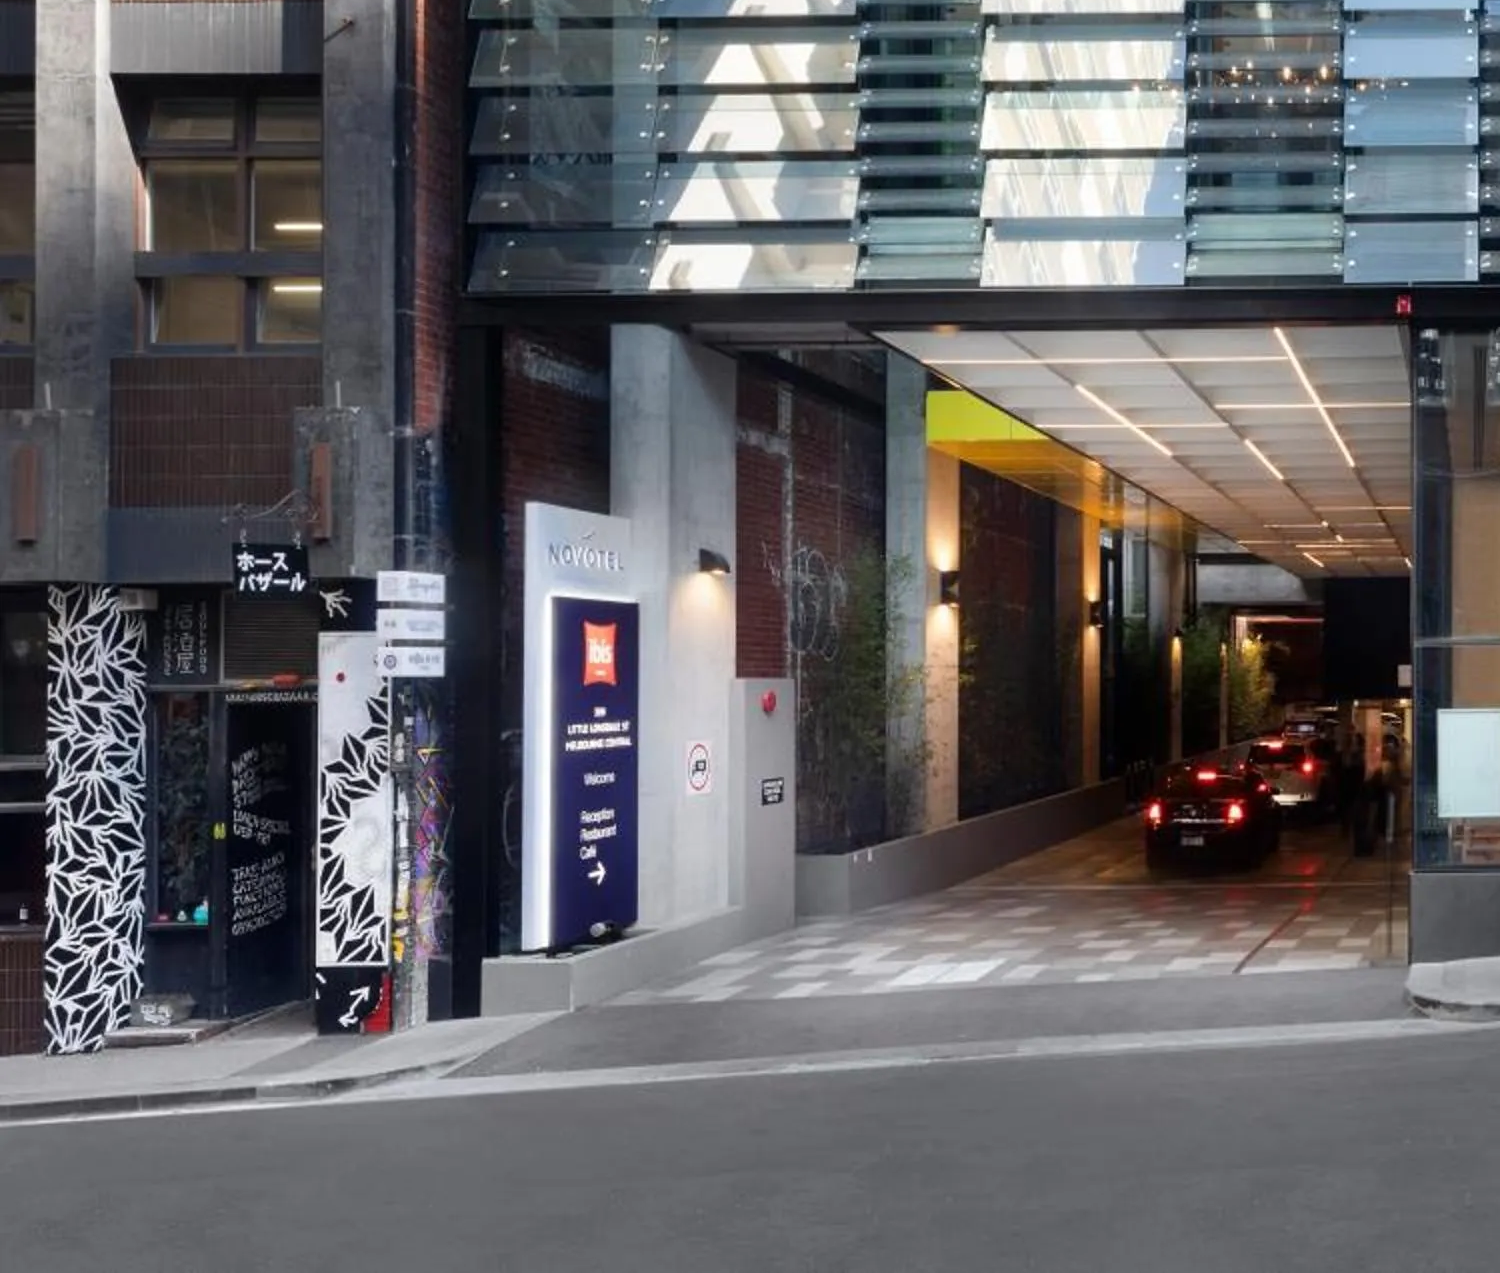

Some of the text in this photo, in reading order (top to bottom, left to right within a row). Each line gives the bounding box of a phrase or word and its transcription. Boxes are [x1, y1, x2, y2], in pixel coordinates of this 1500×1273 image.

[236, 552, 289, 571] ホース
[549, 542, 625, 572] NOVOTEL
[239, 571, 307, 592] バザール
[588, 638, 613, 664] ibis
[583, 771, 615, 786] Welcome
[580, 808, 615, 824] Reception
[580, 824, 617, 842] Restaurant
